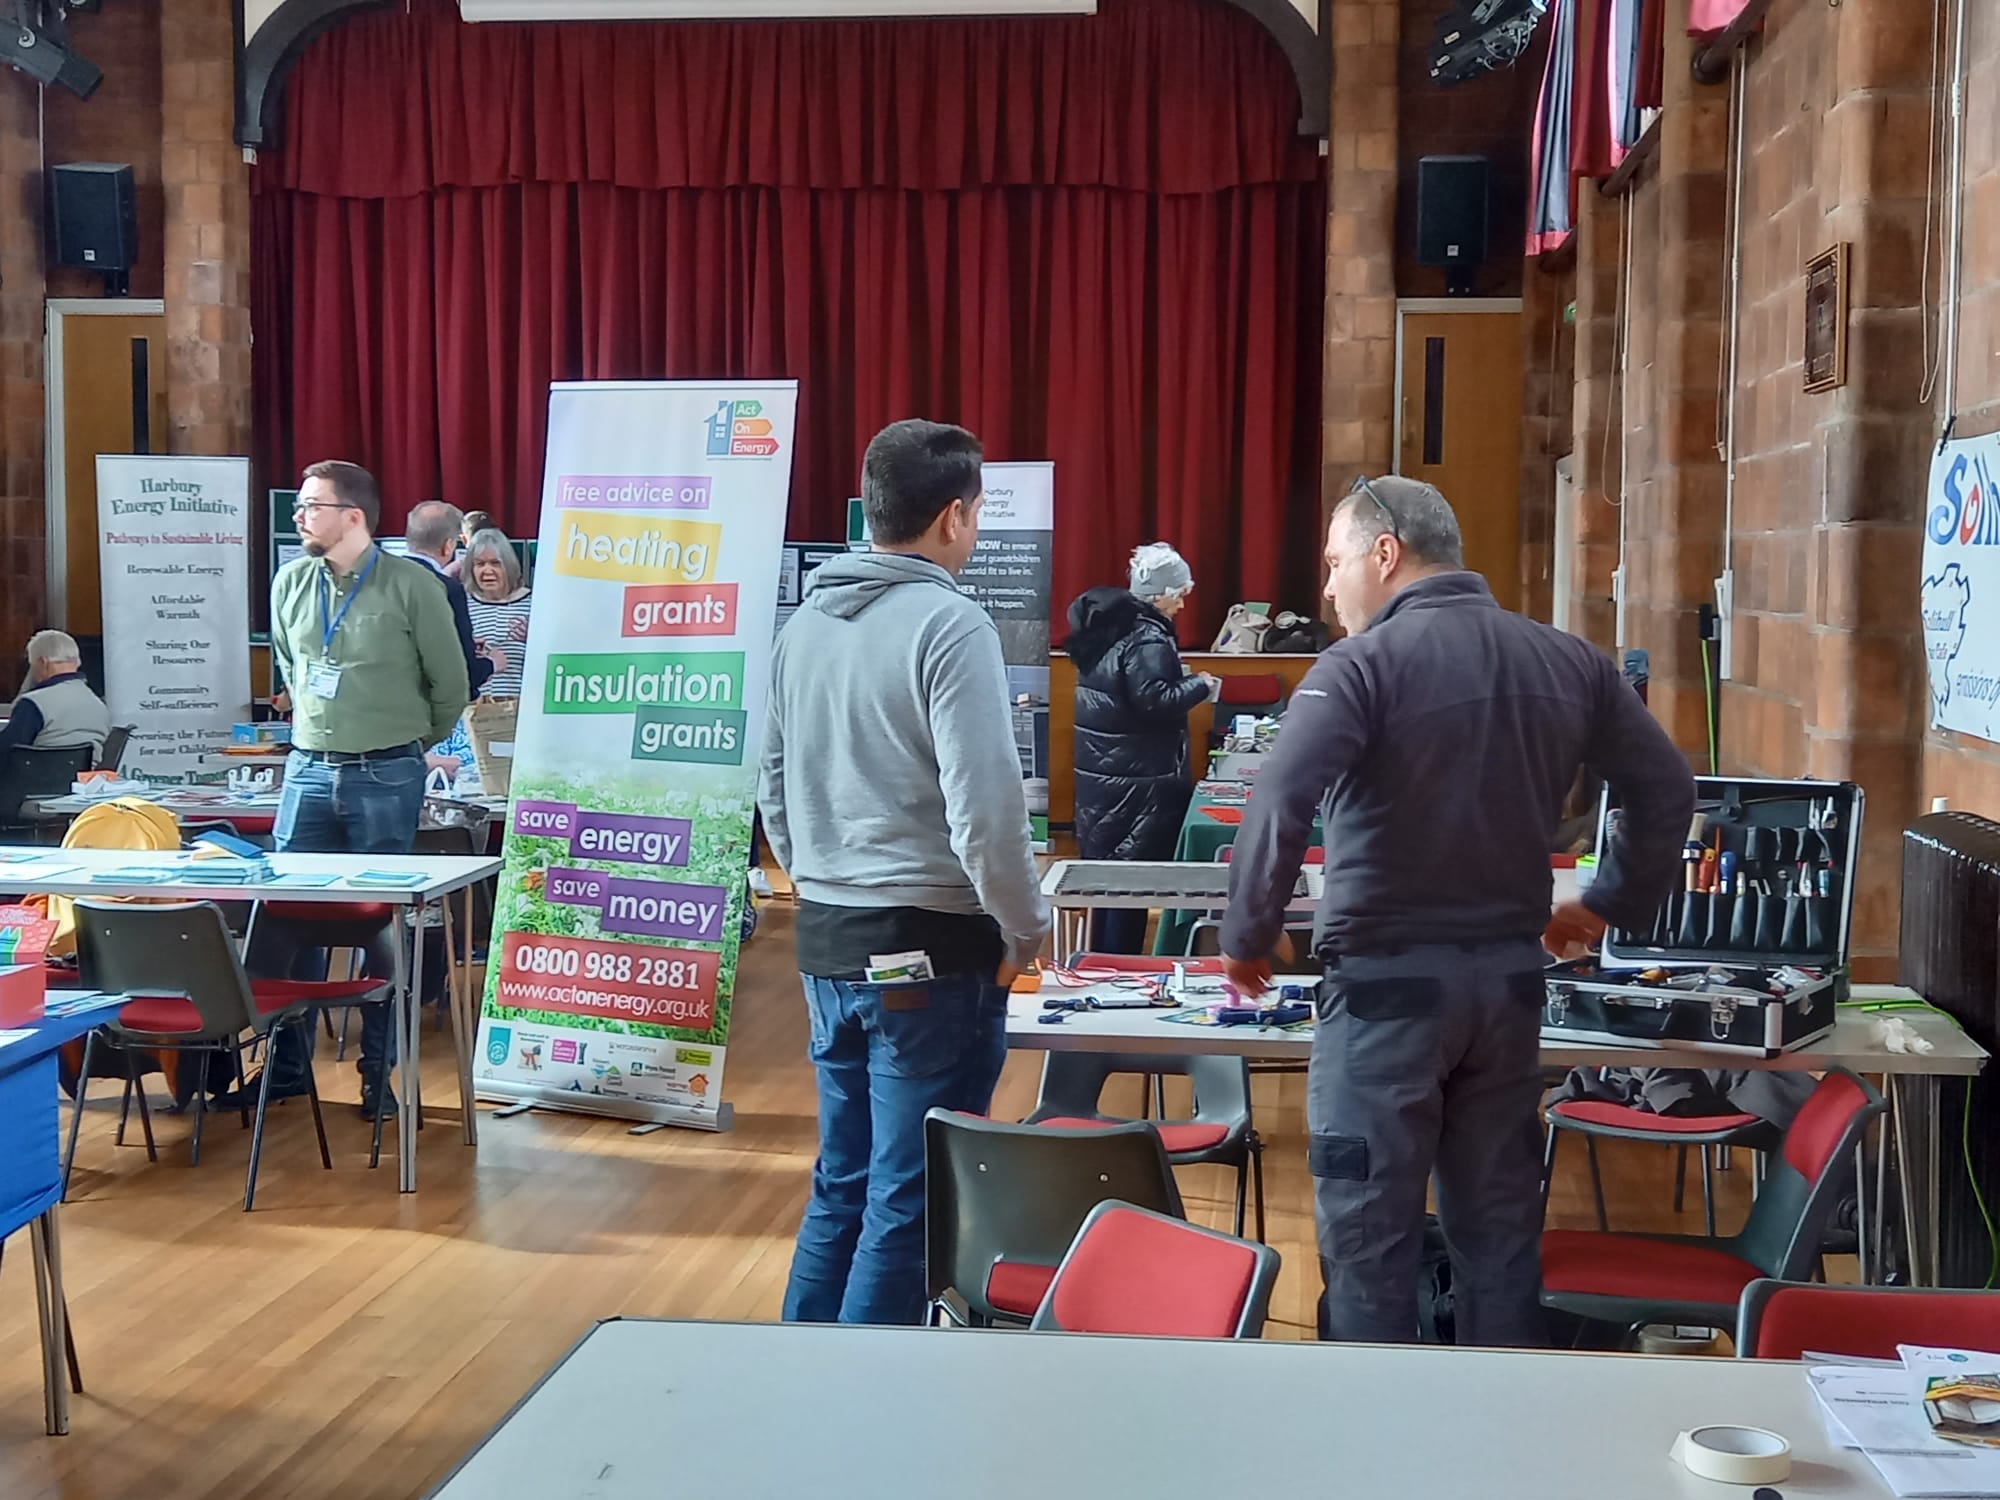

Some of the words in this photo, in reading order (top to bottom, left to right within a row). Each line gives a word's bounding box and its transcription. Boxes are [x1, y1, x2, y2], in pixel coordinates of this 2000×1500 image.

[736, 403, 756, 415] Act
[734, 424, 750, 434] On
[733, 441, 771, 454] Energy
[140, 478, 203, 496] Harbury
[563, 482, 600, 502] free
[607, 483, 674, 502] advice
[680, 487, 706, 504] on
[112, 499, 167, 515] Energy
[170, 497, 238, 516] Initiative
[106, 532, 149, 546] Pathways
[162, 532, 213, 544] Sustainable
[216, 532, 243, 545] Living
[976, 540, 1001, 550] NOW
[567, 523, 710, 582] heating
[972, 554, 987, 562] and
[988, 554, 1040, 564] grandchildren
[127, 564, 184, 574] Renewable
[188, 564, 224, 576] Energy
[151, 594, 205, 604] Affordable
[156, 609, 200, 619] Warmth
[632, 593, 726, 632] grants
[146, 640, 187, 651] Sharing
[190, 640, 210, 649] Our
[152, 655, 206, 665] Resources
[554, 664, 732, 703] insulation
[640, 719, 736, 752] grants
[520, 810, 568, 830] save
[580, 827, 682, 864] energy
[553, 877, 600, 897] save
[609, 894, 718, 934] money
[516, 945, 579, 976] 0800
[584, 952, 632, 983] 988
[636, 957, 699, 990] 2881
[502, 981, 709, 1020] www.actonenergy.org.uk
